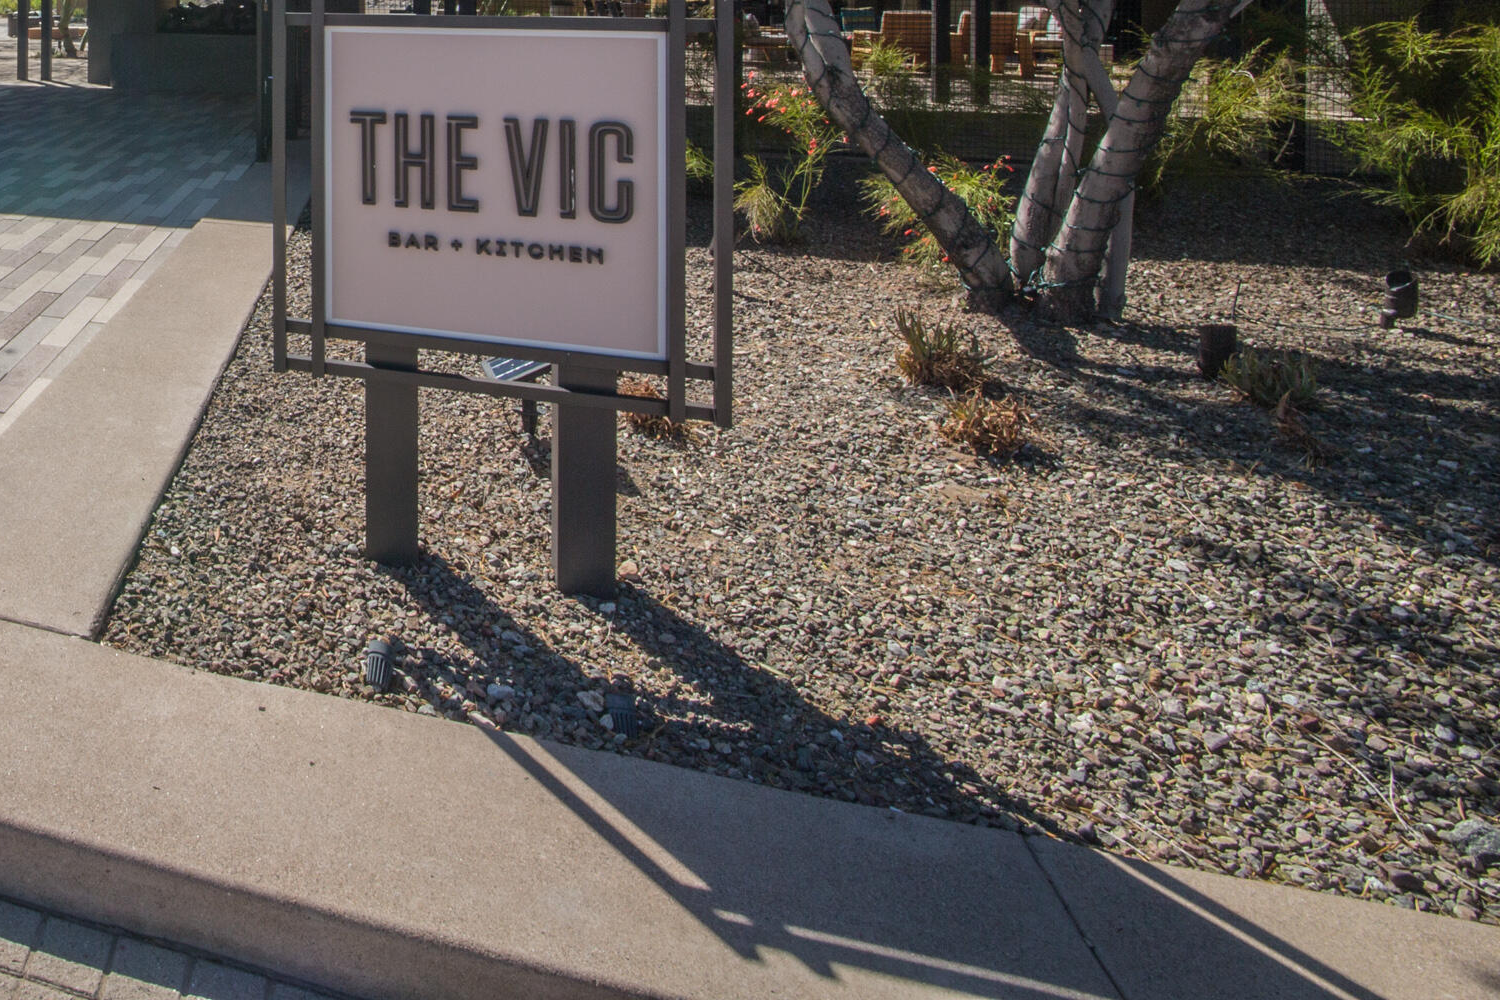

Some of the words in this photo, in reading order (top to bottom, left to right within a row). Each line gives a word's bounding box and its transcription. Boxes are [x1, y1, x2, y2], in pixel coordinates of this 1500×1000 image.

[349, 110, 480, 213] THE
[503, 116, 634, 224] VIC
[388, 231, 439, 252] BAR
[476, 238, 605, 265] KITCHEN
